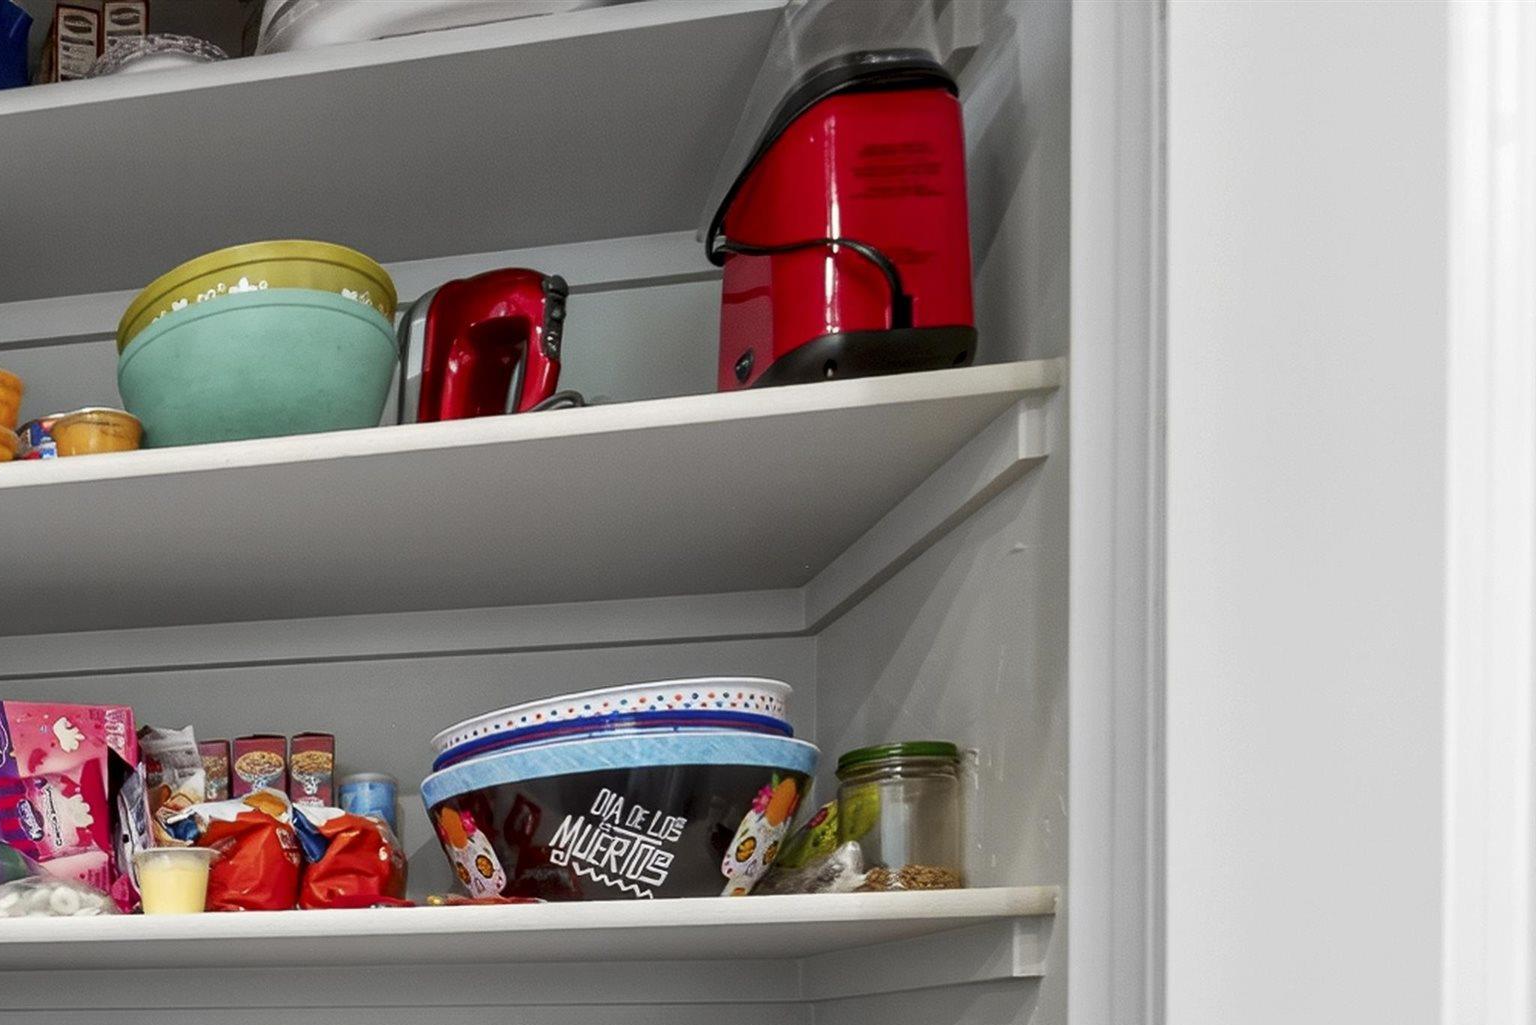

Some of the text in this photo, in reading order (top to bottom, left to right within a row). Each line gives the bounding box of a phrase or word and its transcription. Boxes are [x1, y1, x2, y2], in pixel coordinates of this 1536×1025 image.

[590, 788, 689, 842] DIA DE LOS
[548, 814, 676, 887] MUERTOS
